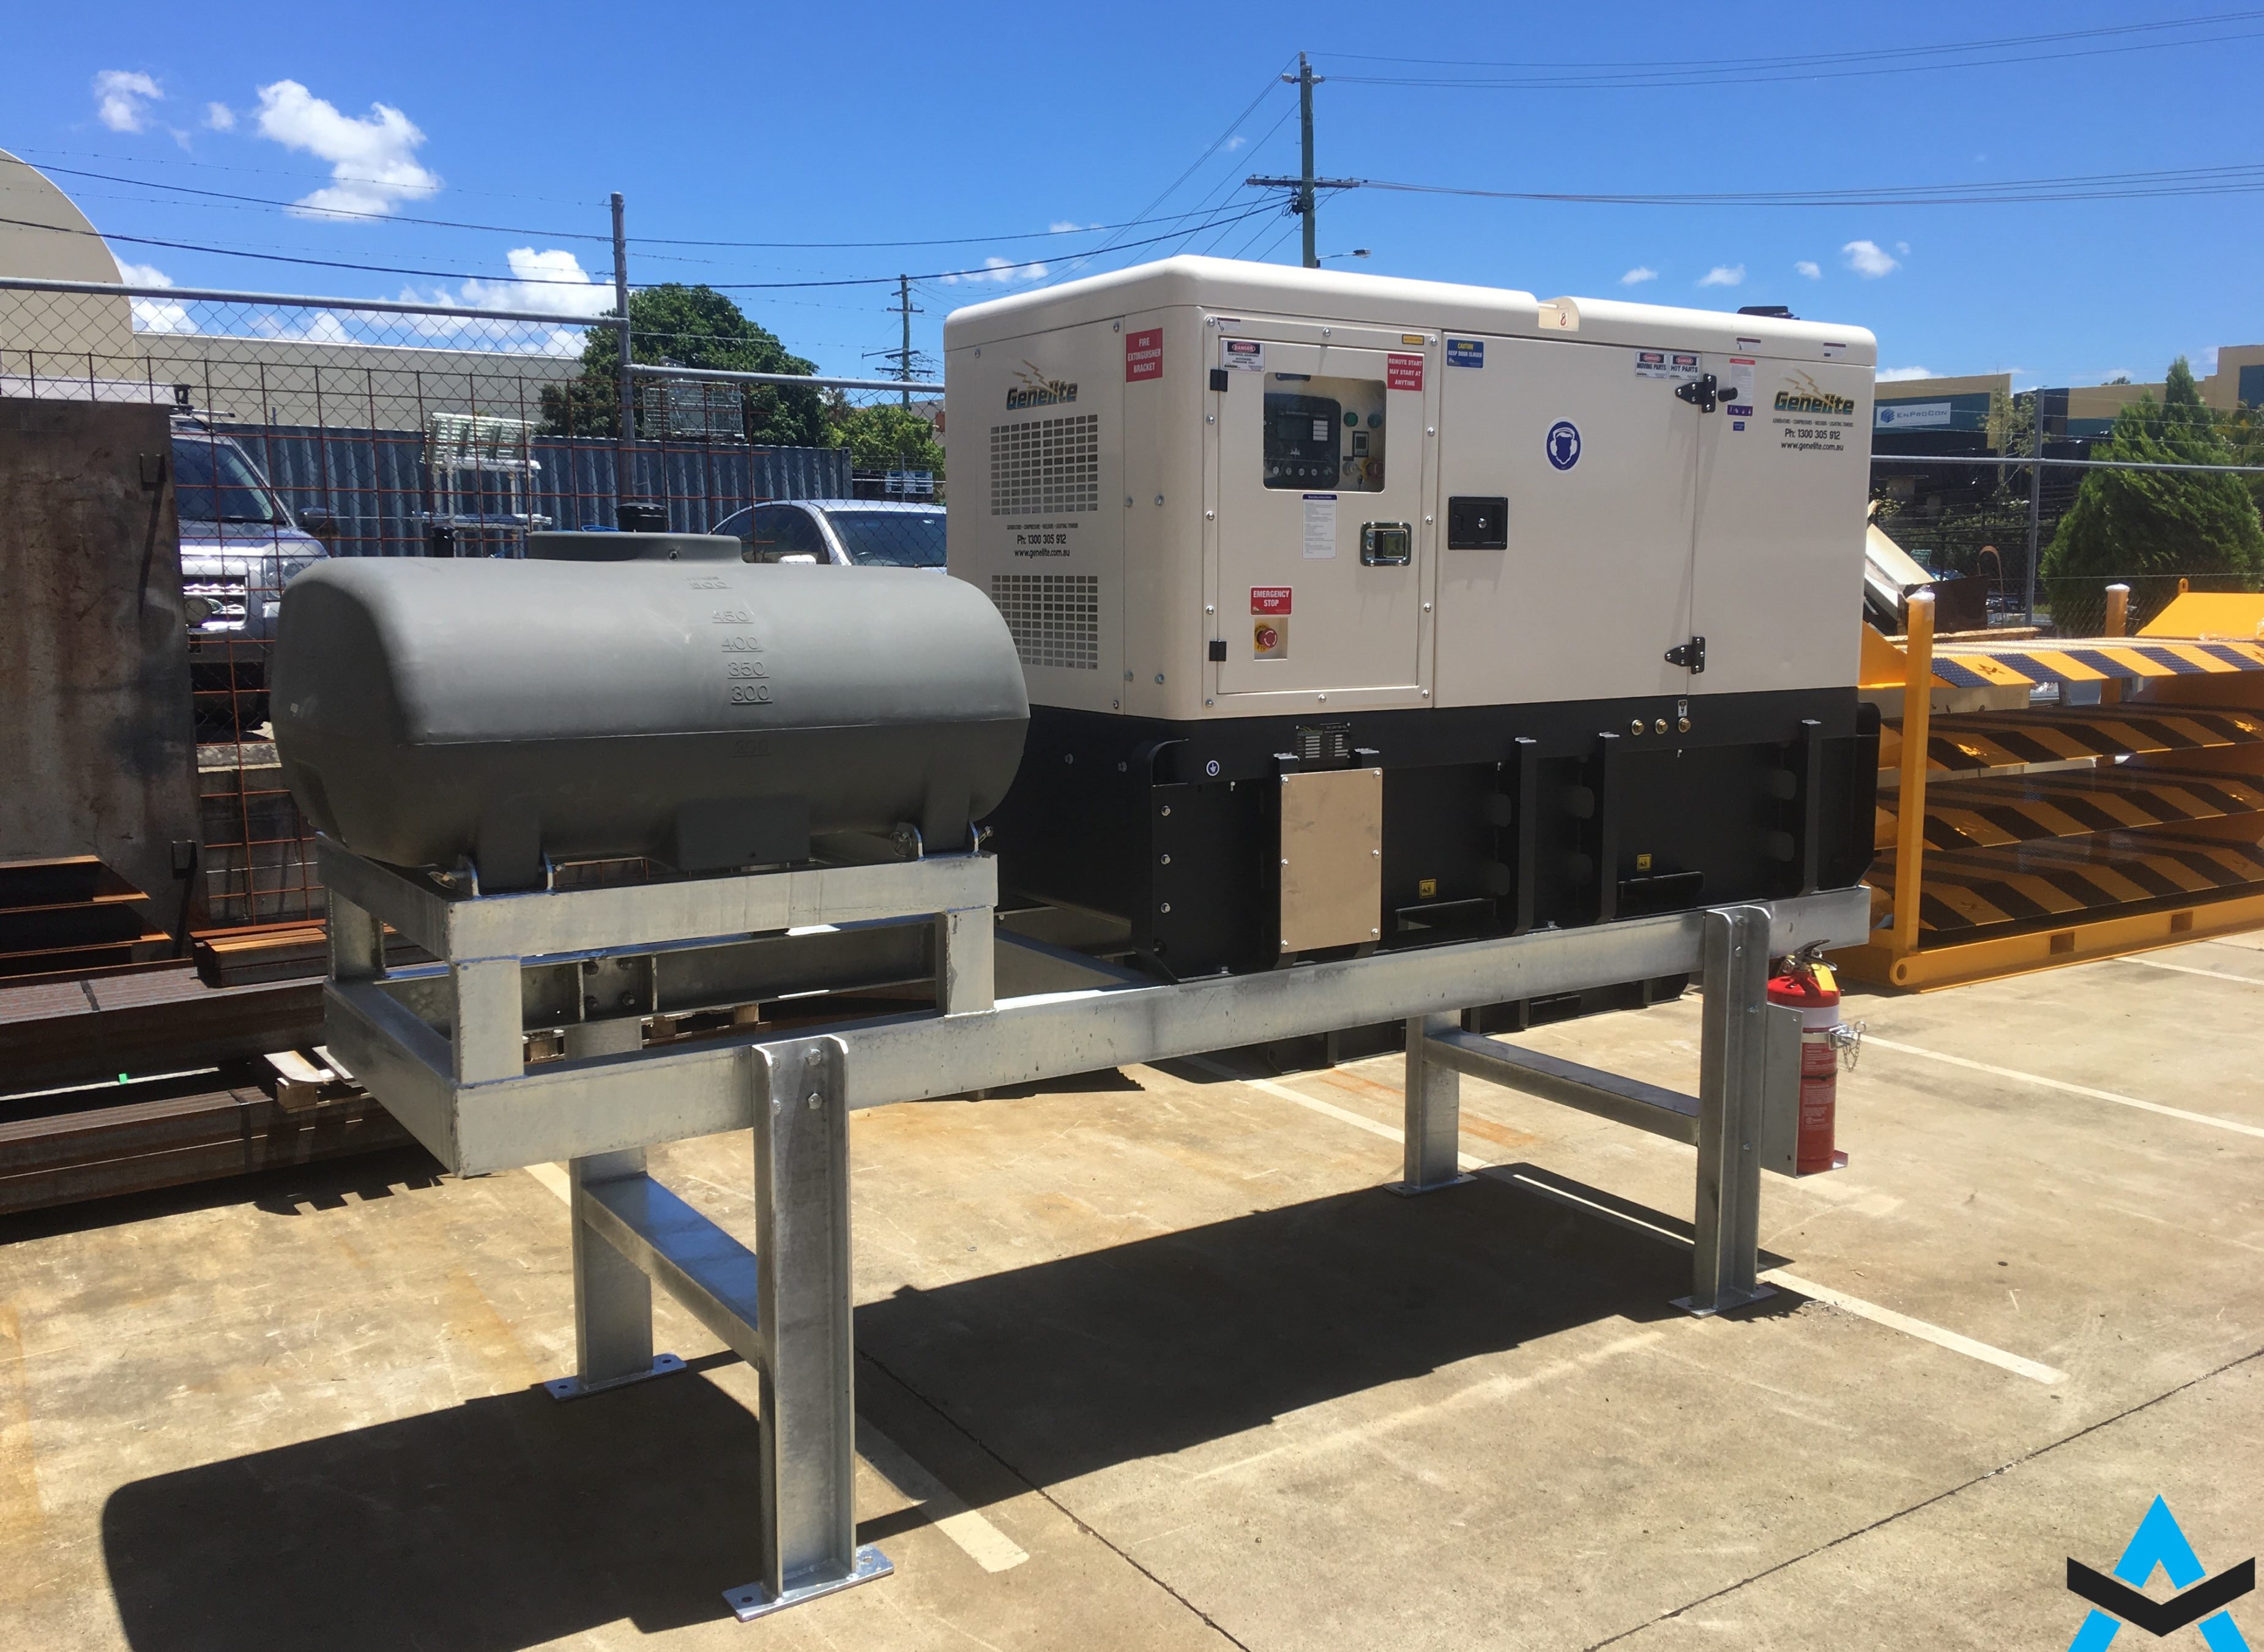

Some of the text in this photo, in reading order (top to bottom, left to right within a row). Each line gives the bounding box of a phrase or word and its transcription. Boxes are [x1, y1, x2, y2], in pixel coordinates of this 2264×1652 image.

[1139, 337, 1150, 347] FIRE
[1128, 348, 1161, 362] EXTINGUISHER
[1133, 362, 1156, 373] BRACKET
[1007, 380, 1078, 411] Genelite
[1773, 390, 1855, 415] Genelite
[1785, 428, 1841, 440] Ph: 1300 305 912
[1781, 442, 1844, 451] www.genelite.com.au
[1017, 534, 1067, 544] Ph: 1300 305 912
[1014, 548, 1070, 559] www.genelite.com.au
[712, 611, 750, 622] 450
[721, 637, 760, 650] 400
[728, 661, 766, 677] 350
[731, 685, 770, 702] 300
